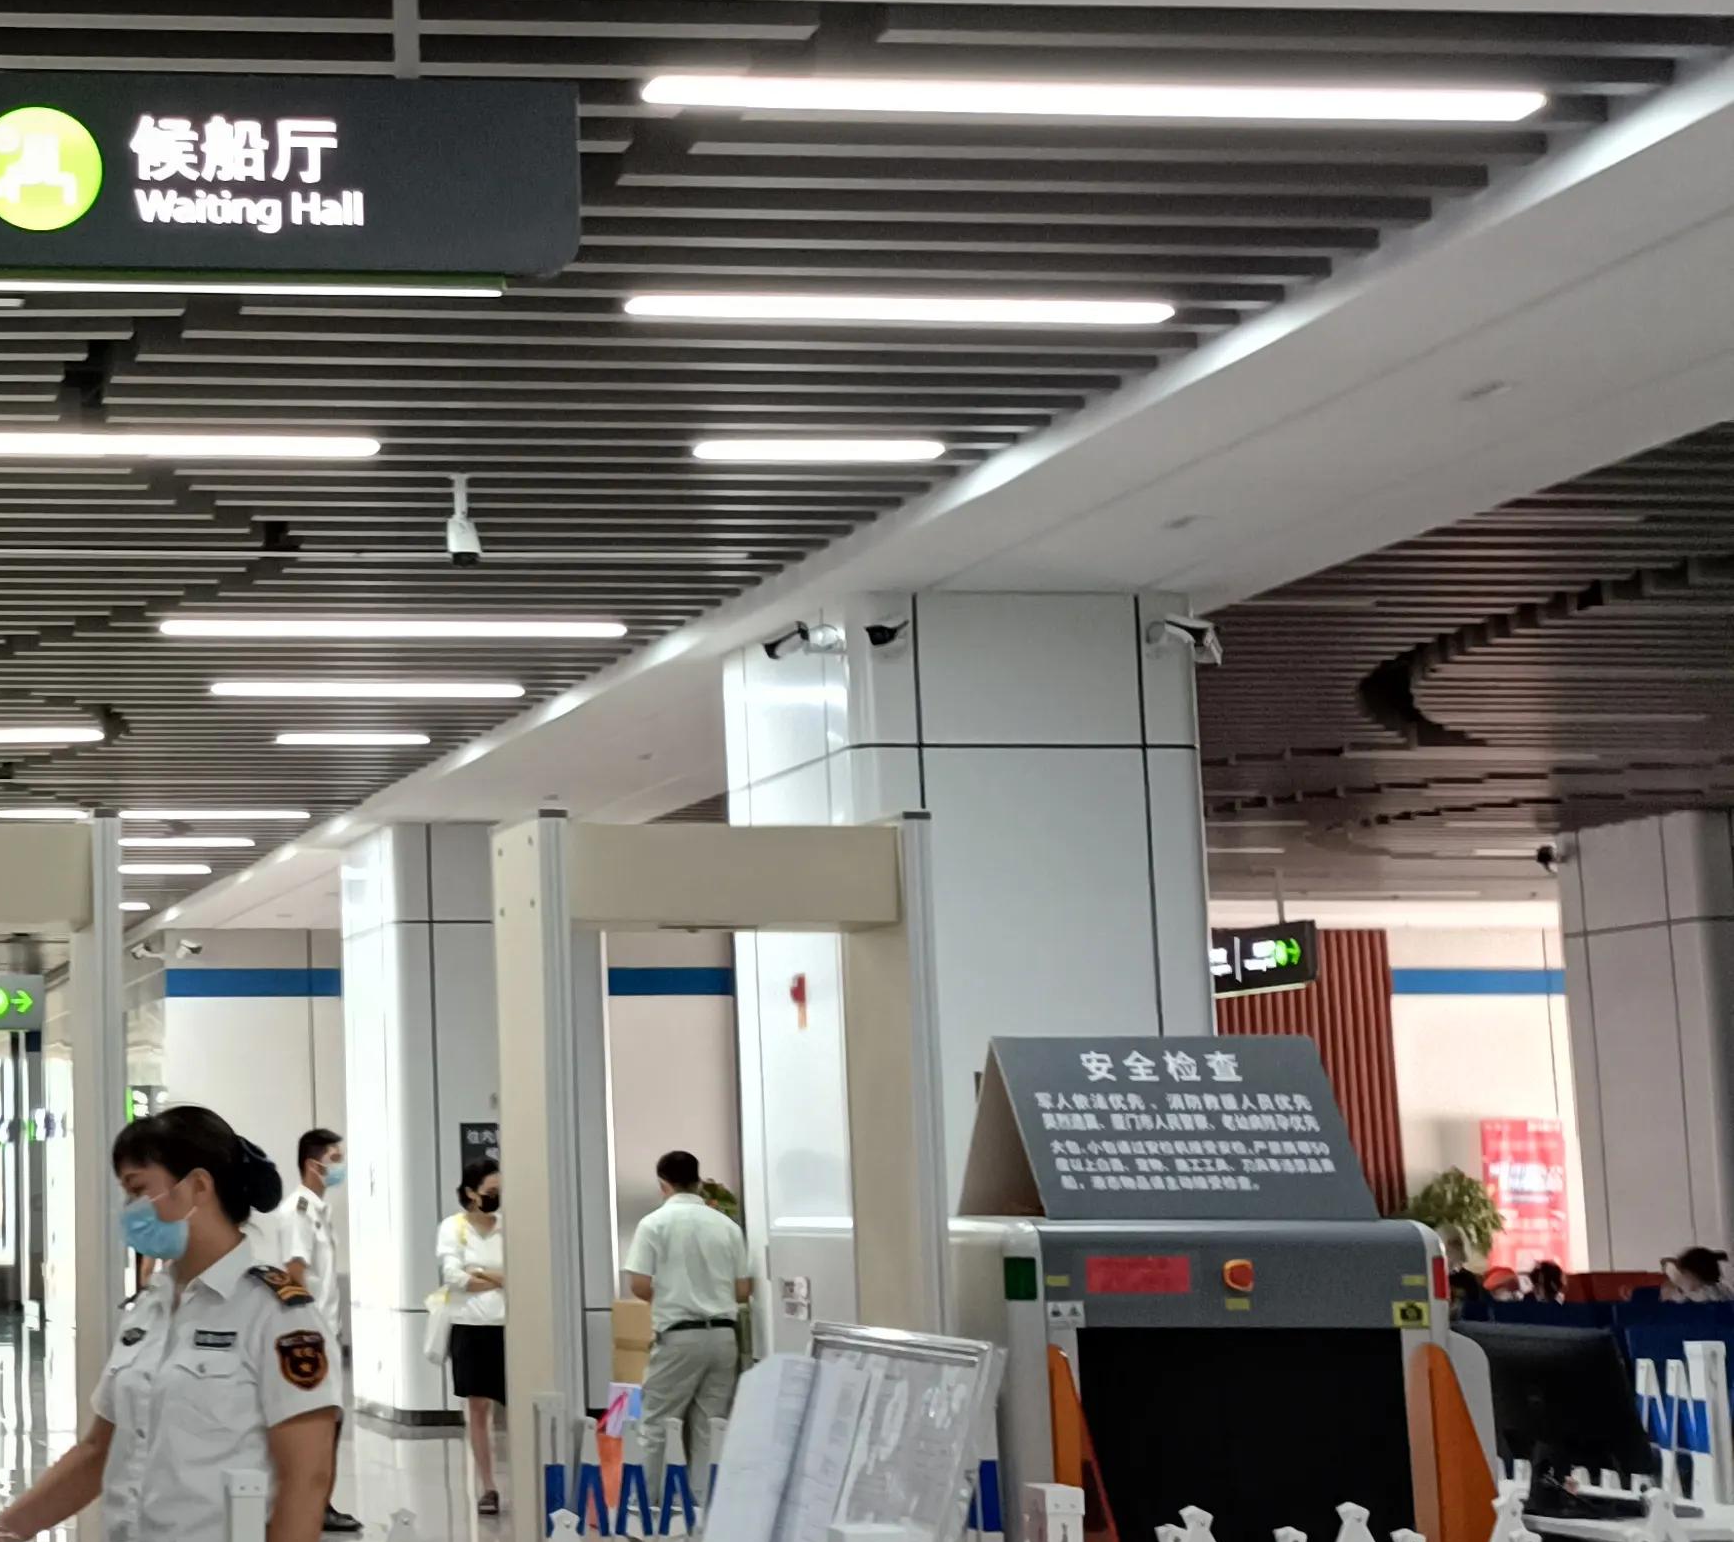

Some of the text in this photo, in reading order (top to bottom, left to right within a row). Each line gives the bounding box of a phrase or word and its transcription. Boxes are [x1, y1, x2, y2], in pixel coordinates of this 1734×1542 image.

[129, 114, 338, 184] 候船厅
[133, 188, 365, 234] Waiting Hall
[1079, 1050, 1243, 1082] 安全检查
